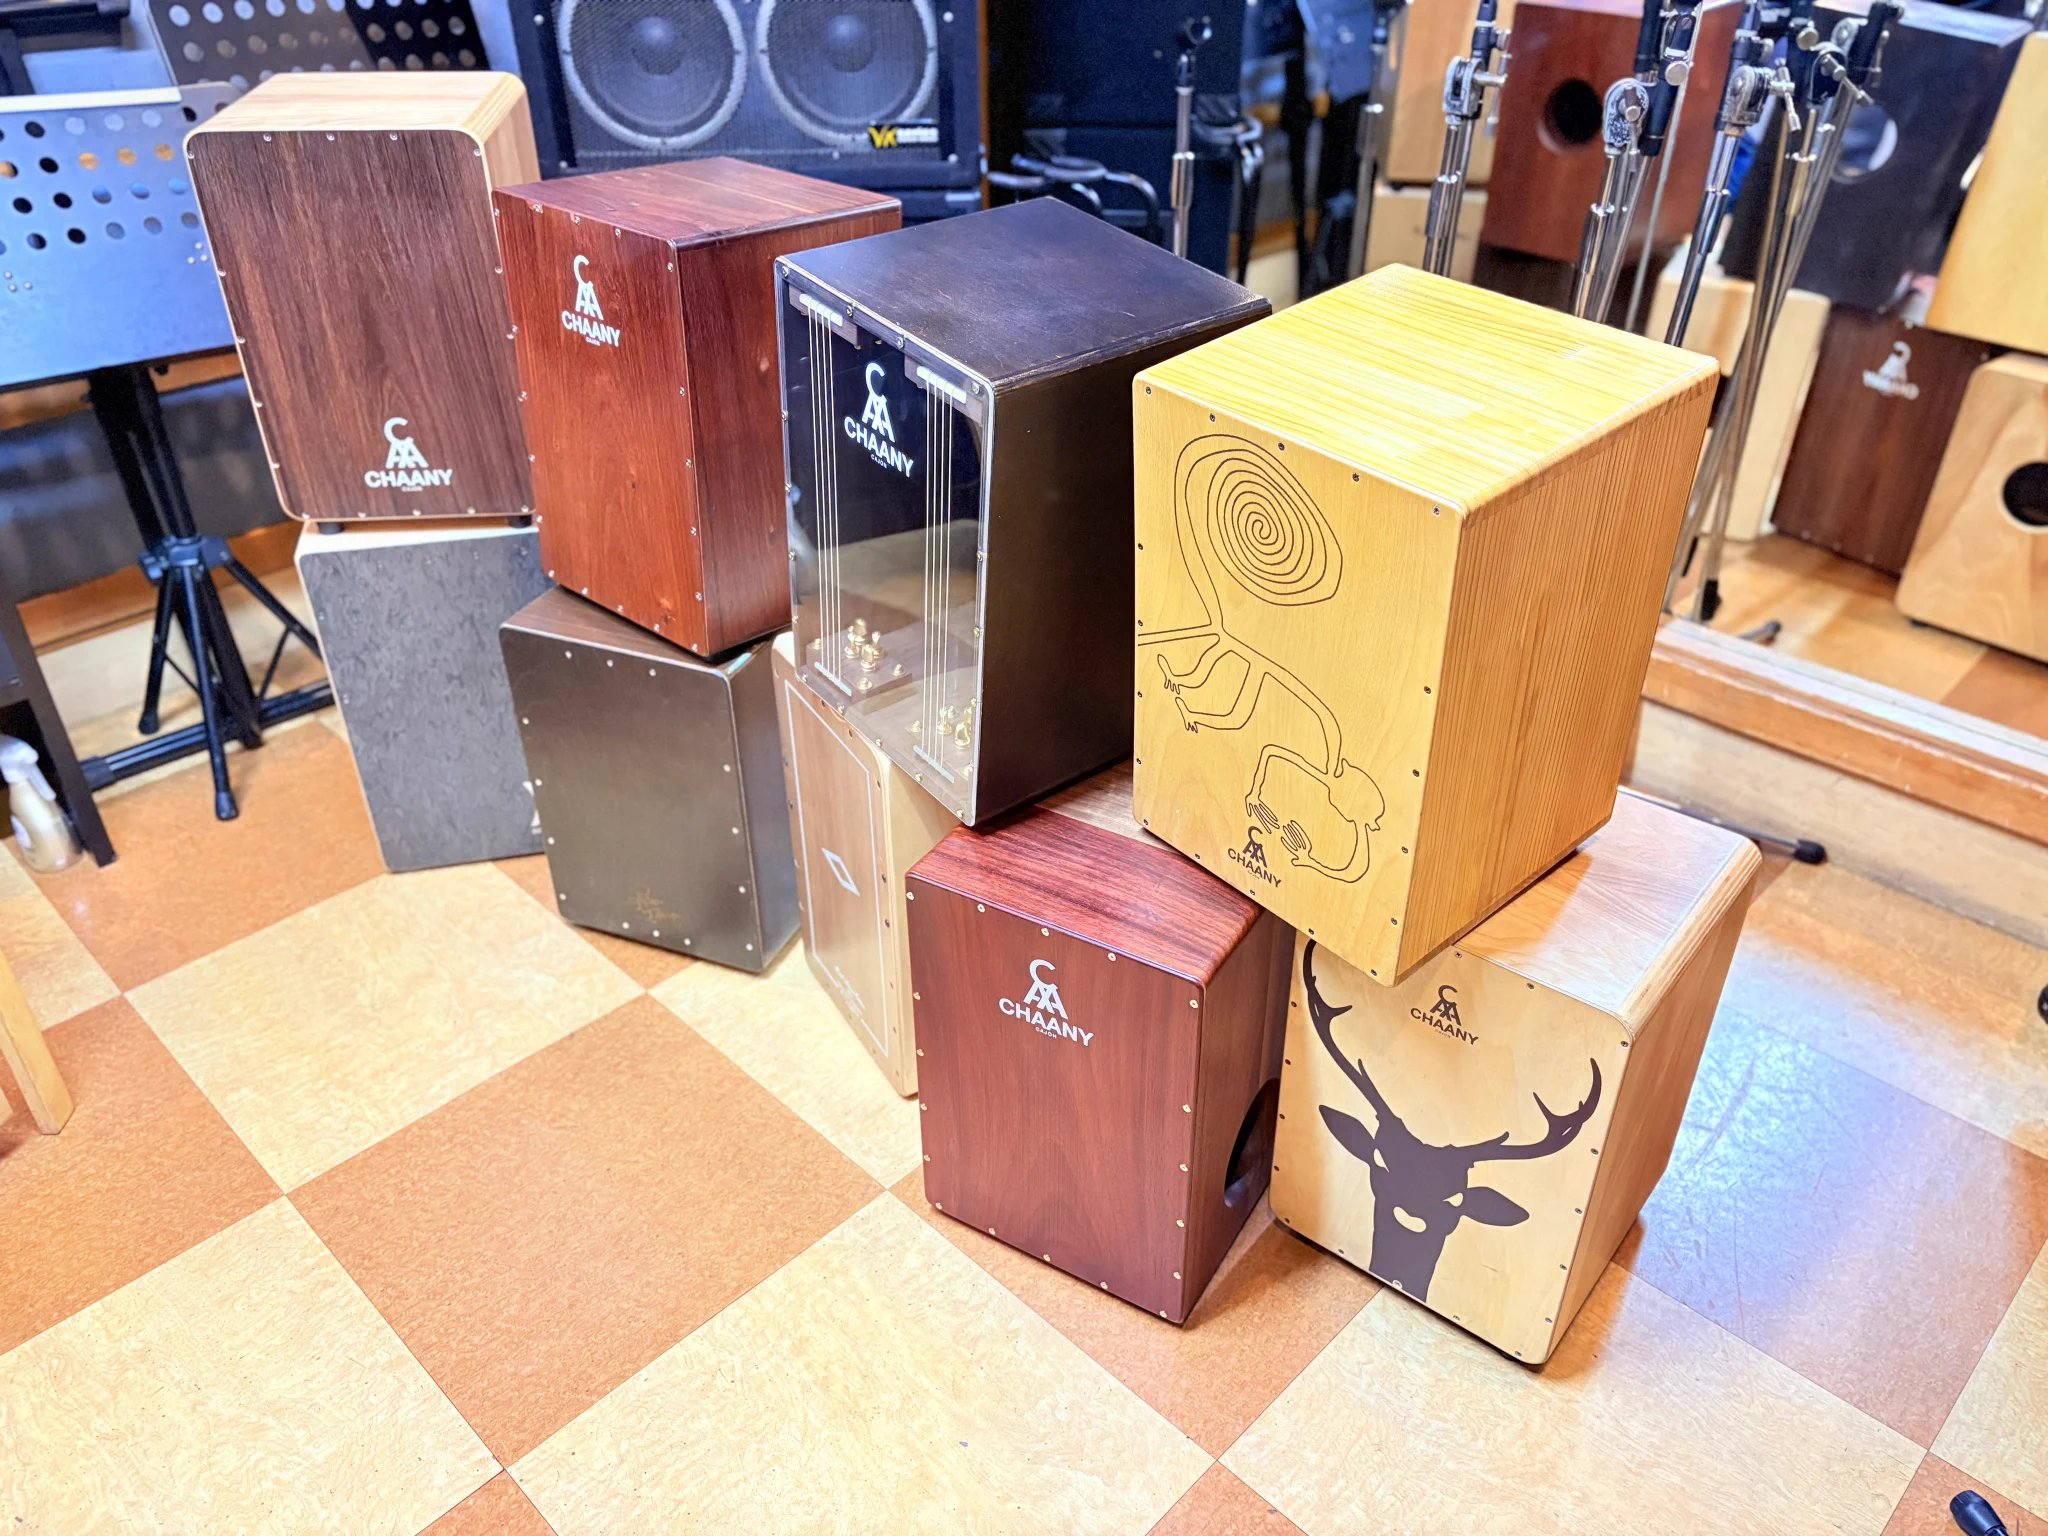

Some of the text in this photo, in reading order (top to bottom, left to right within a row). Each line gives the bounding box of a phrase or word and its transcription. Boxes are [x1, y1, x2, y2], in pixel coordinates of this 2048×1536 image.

[562, 310, 620, 347] CHAANY
[844, 416, 914, 478] CHAANY
[364, 469, 453, 488] CHAANY
[1228, 848, 1282, 888] CHAANY
[999, 997, 1094, 1047] CHAANY
[1410, 1007, 1479, 1045] CHAANY
